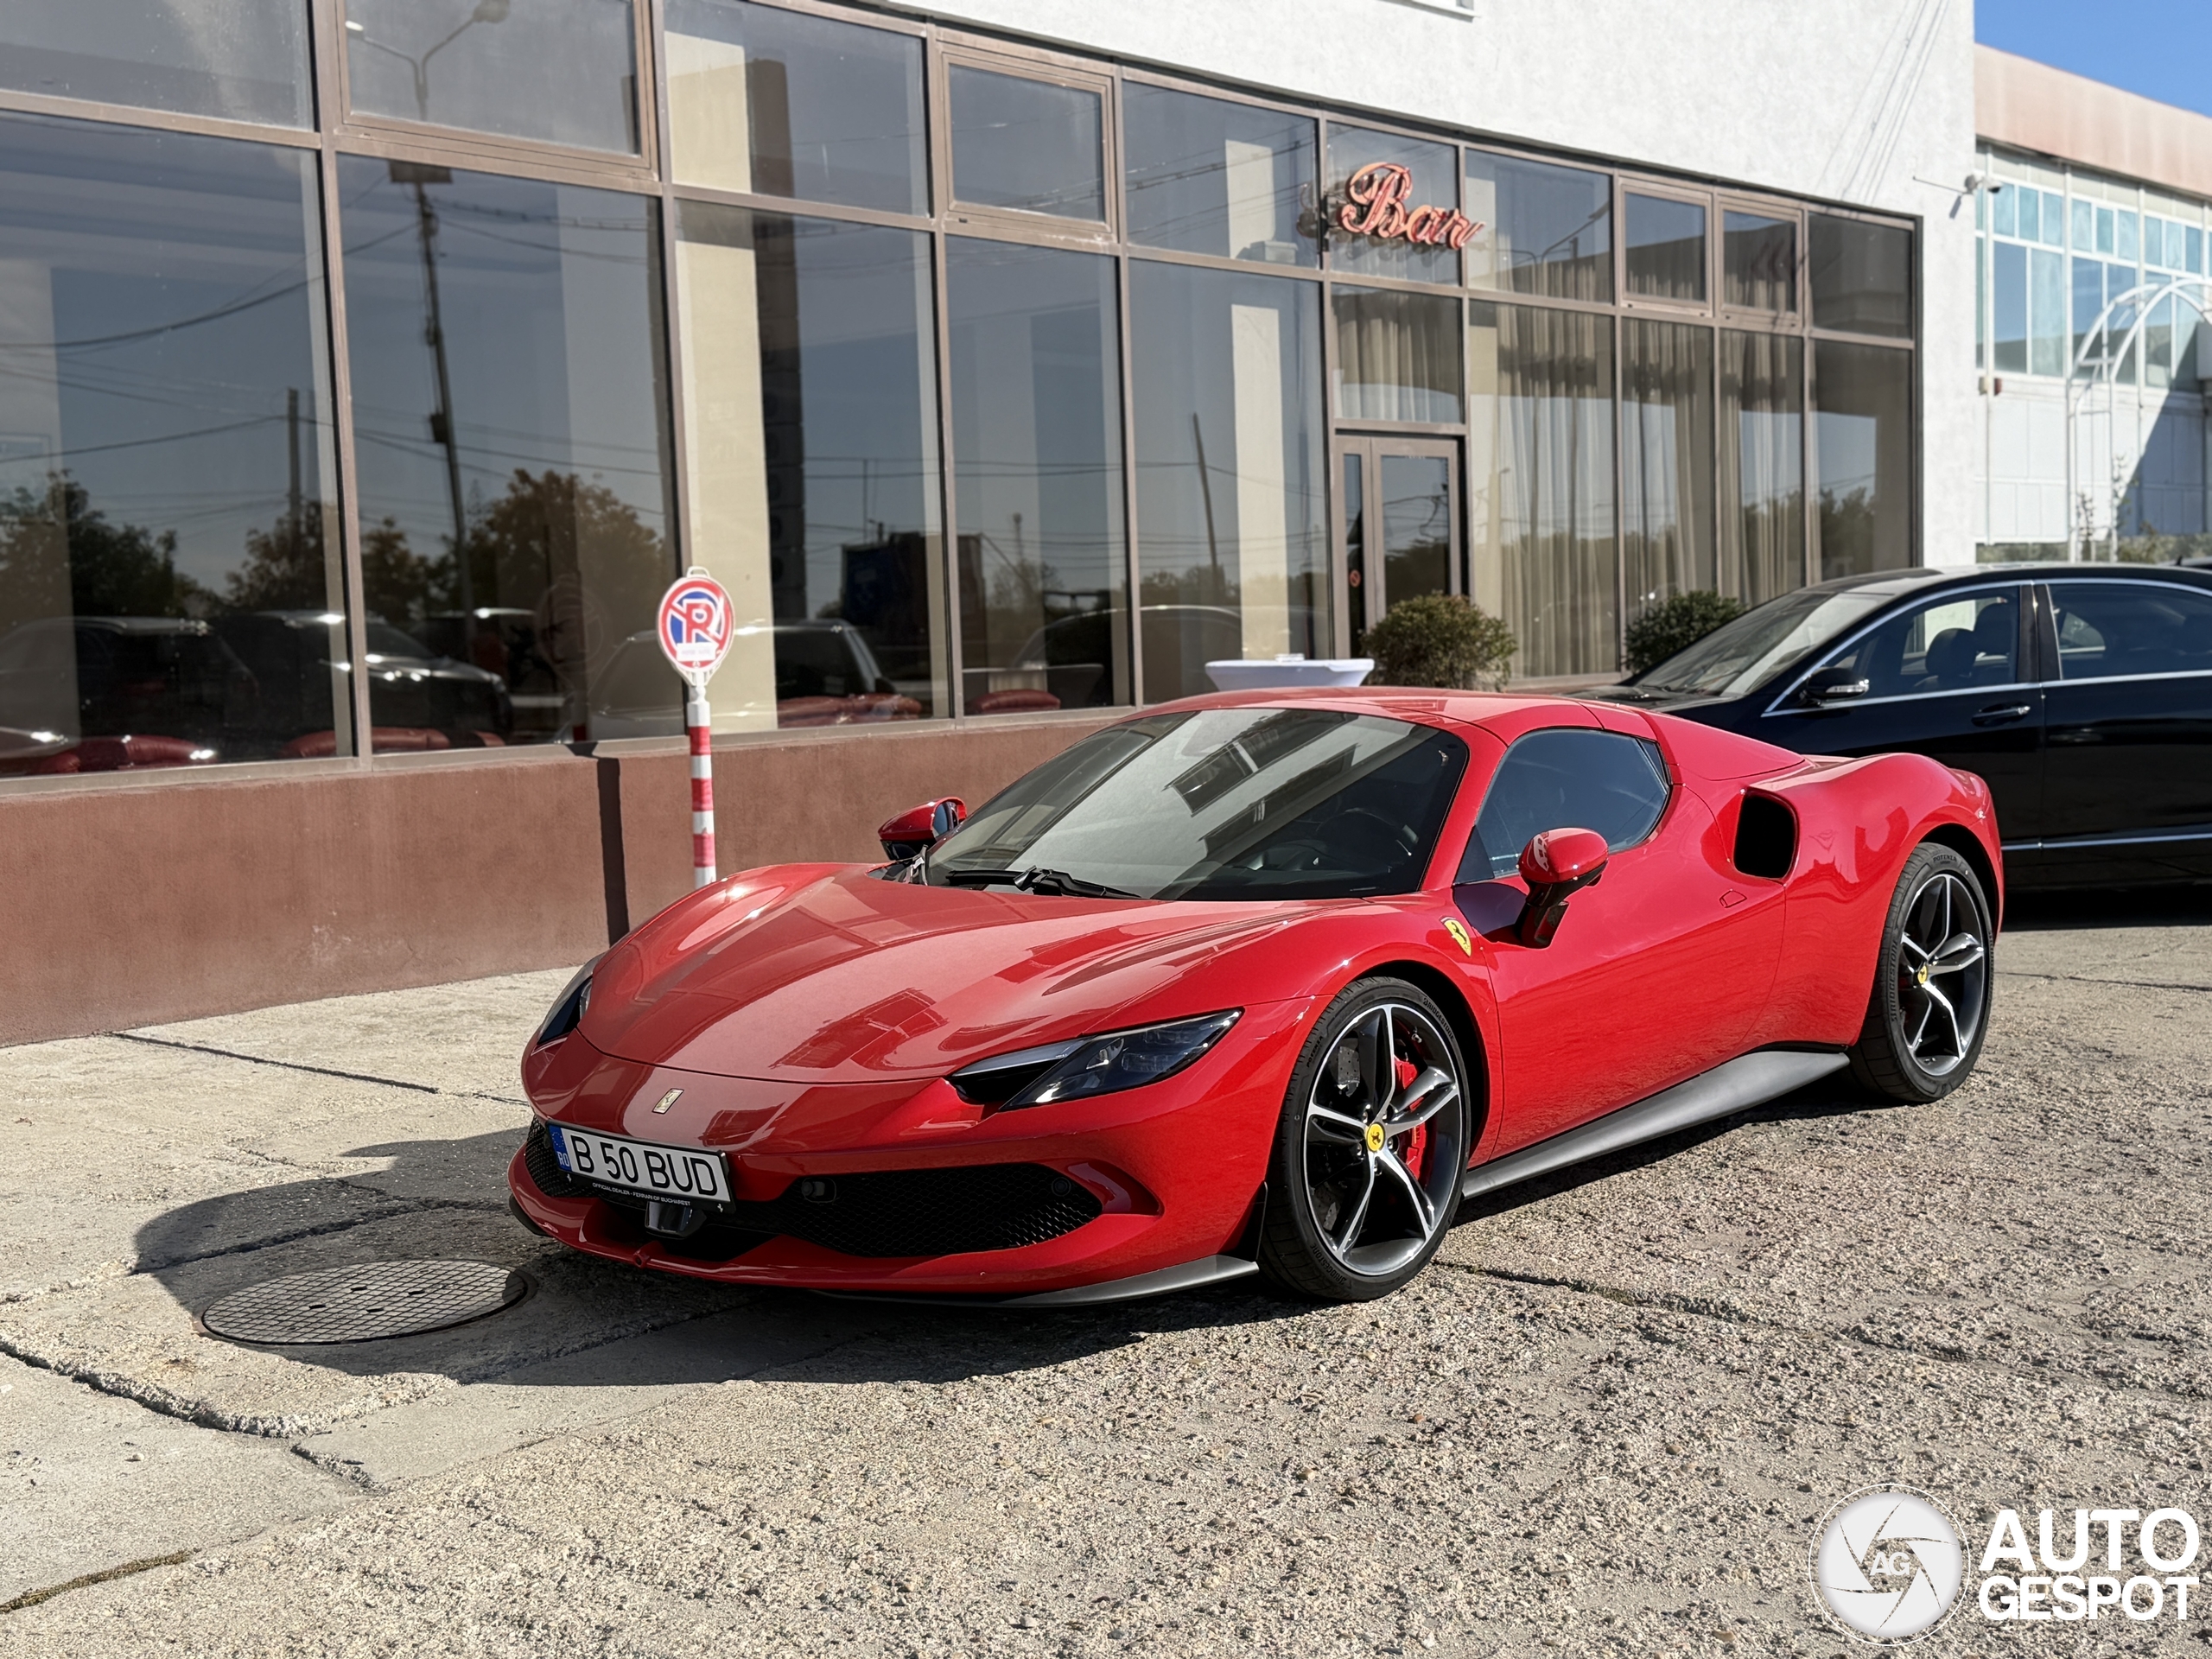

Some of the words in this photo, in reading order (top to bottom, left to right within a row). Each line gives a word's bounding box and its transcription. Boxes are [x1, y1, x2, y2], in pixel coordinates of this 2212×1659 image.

[1341, 162, 1486, 251] Bar
[557, 1151, 570, 1166] RO
[570, 1134, 594, 1173] B
[600, 1141, 639, 1184] 50
[644, 1149, 718, 1196] BUD
[592, 1182, 613, 1192] OFFICIAL
[612, 1187, 631, 1196] DEALER
[632, 1192, 653, 1200] FERRARI
[661, 1197, 690, 1206] BUCHAREST
